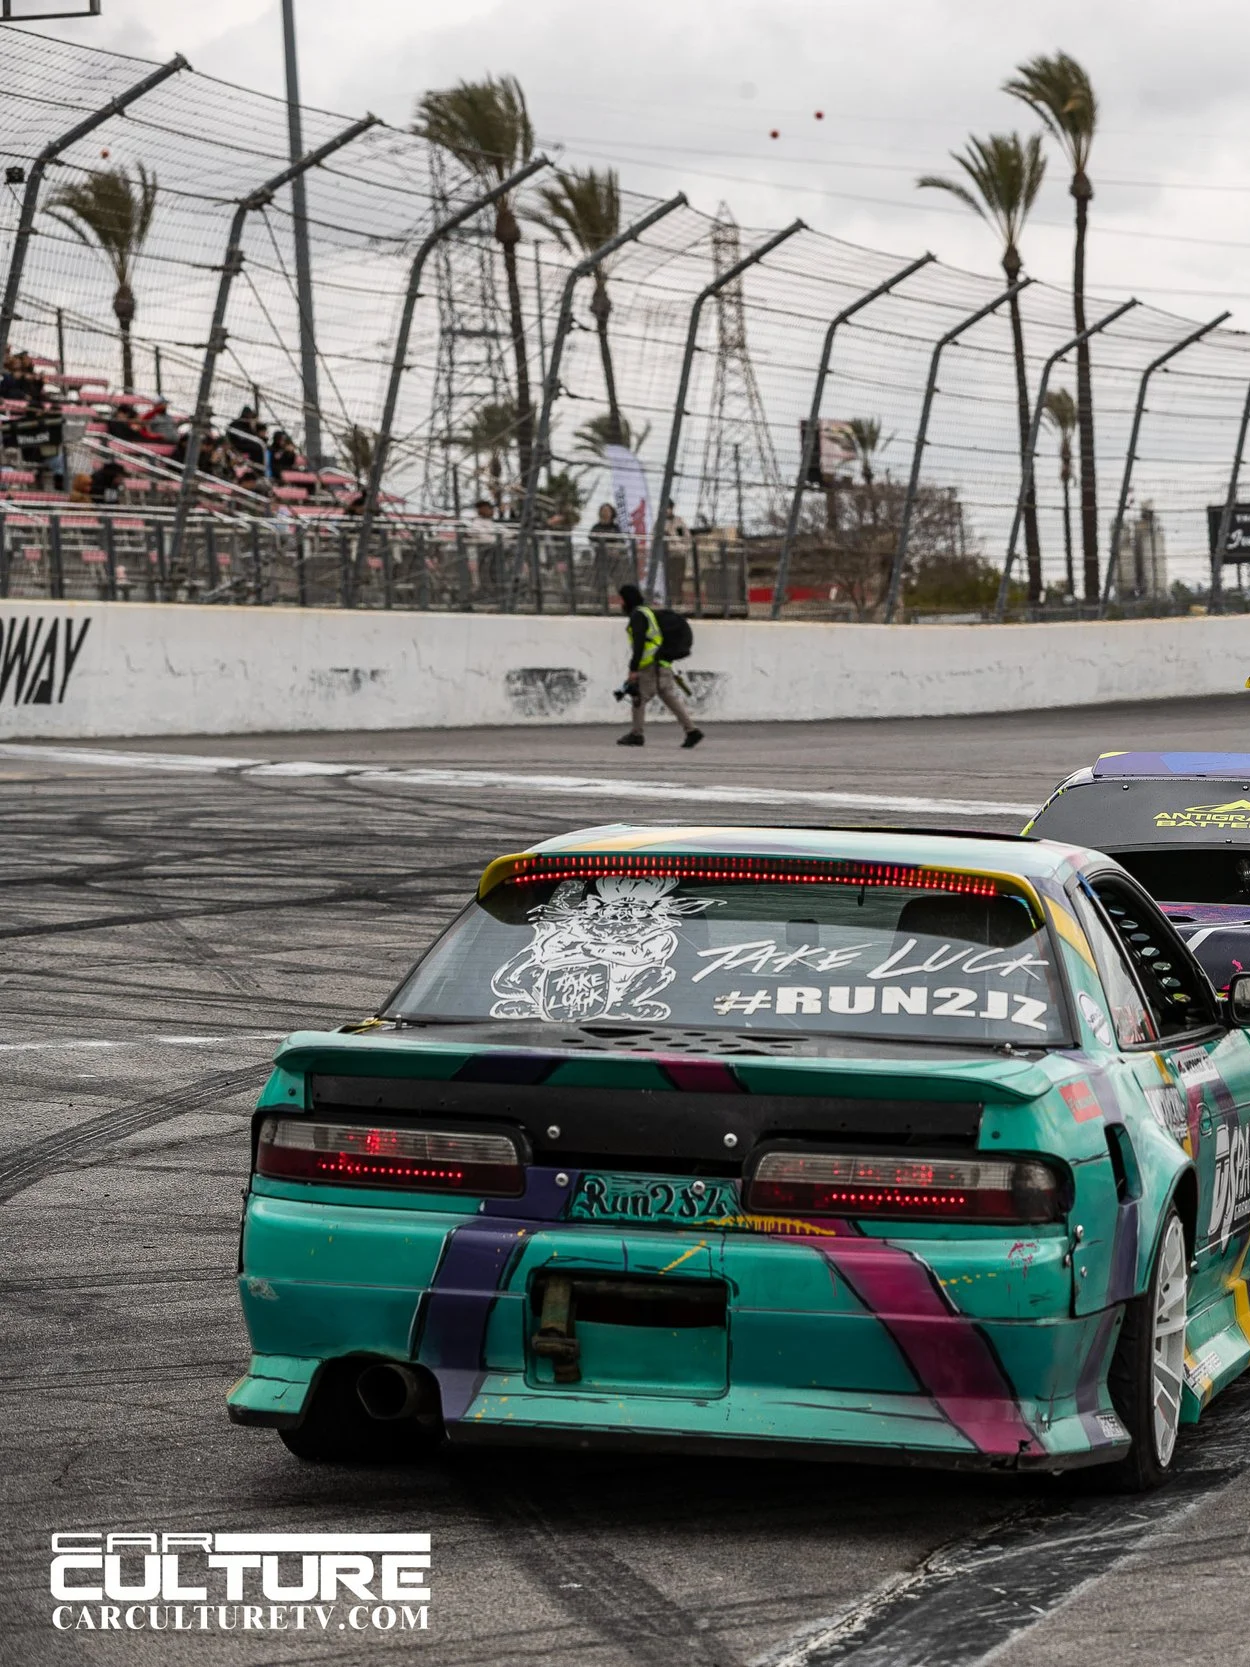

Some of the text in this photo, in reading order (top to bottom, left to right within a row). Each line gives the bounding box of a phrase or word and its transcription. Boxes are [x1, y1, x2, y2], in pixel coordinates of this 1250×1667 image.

[0, 616, 92, 706] WAY
[691, 938, 1050, 983] TAKE LUCK
[713, 985, 1048, 1031] #RUN2JZ
